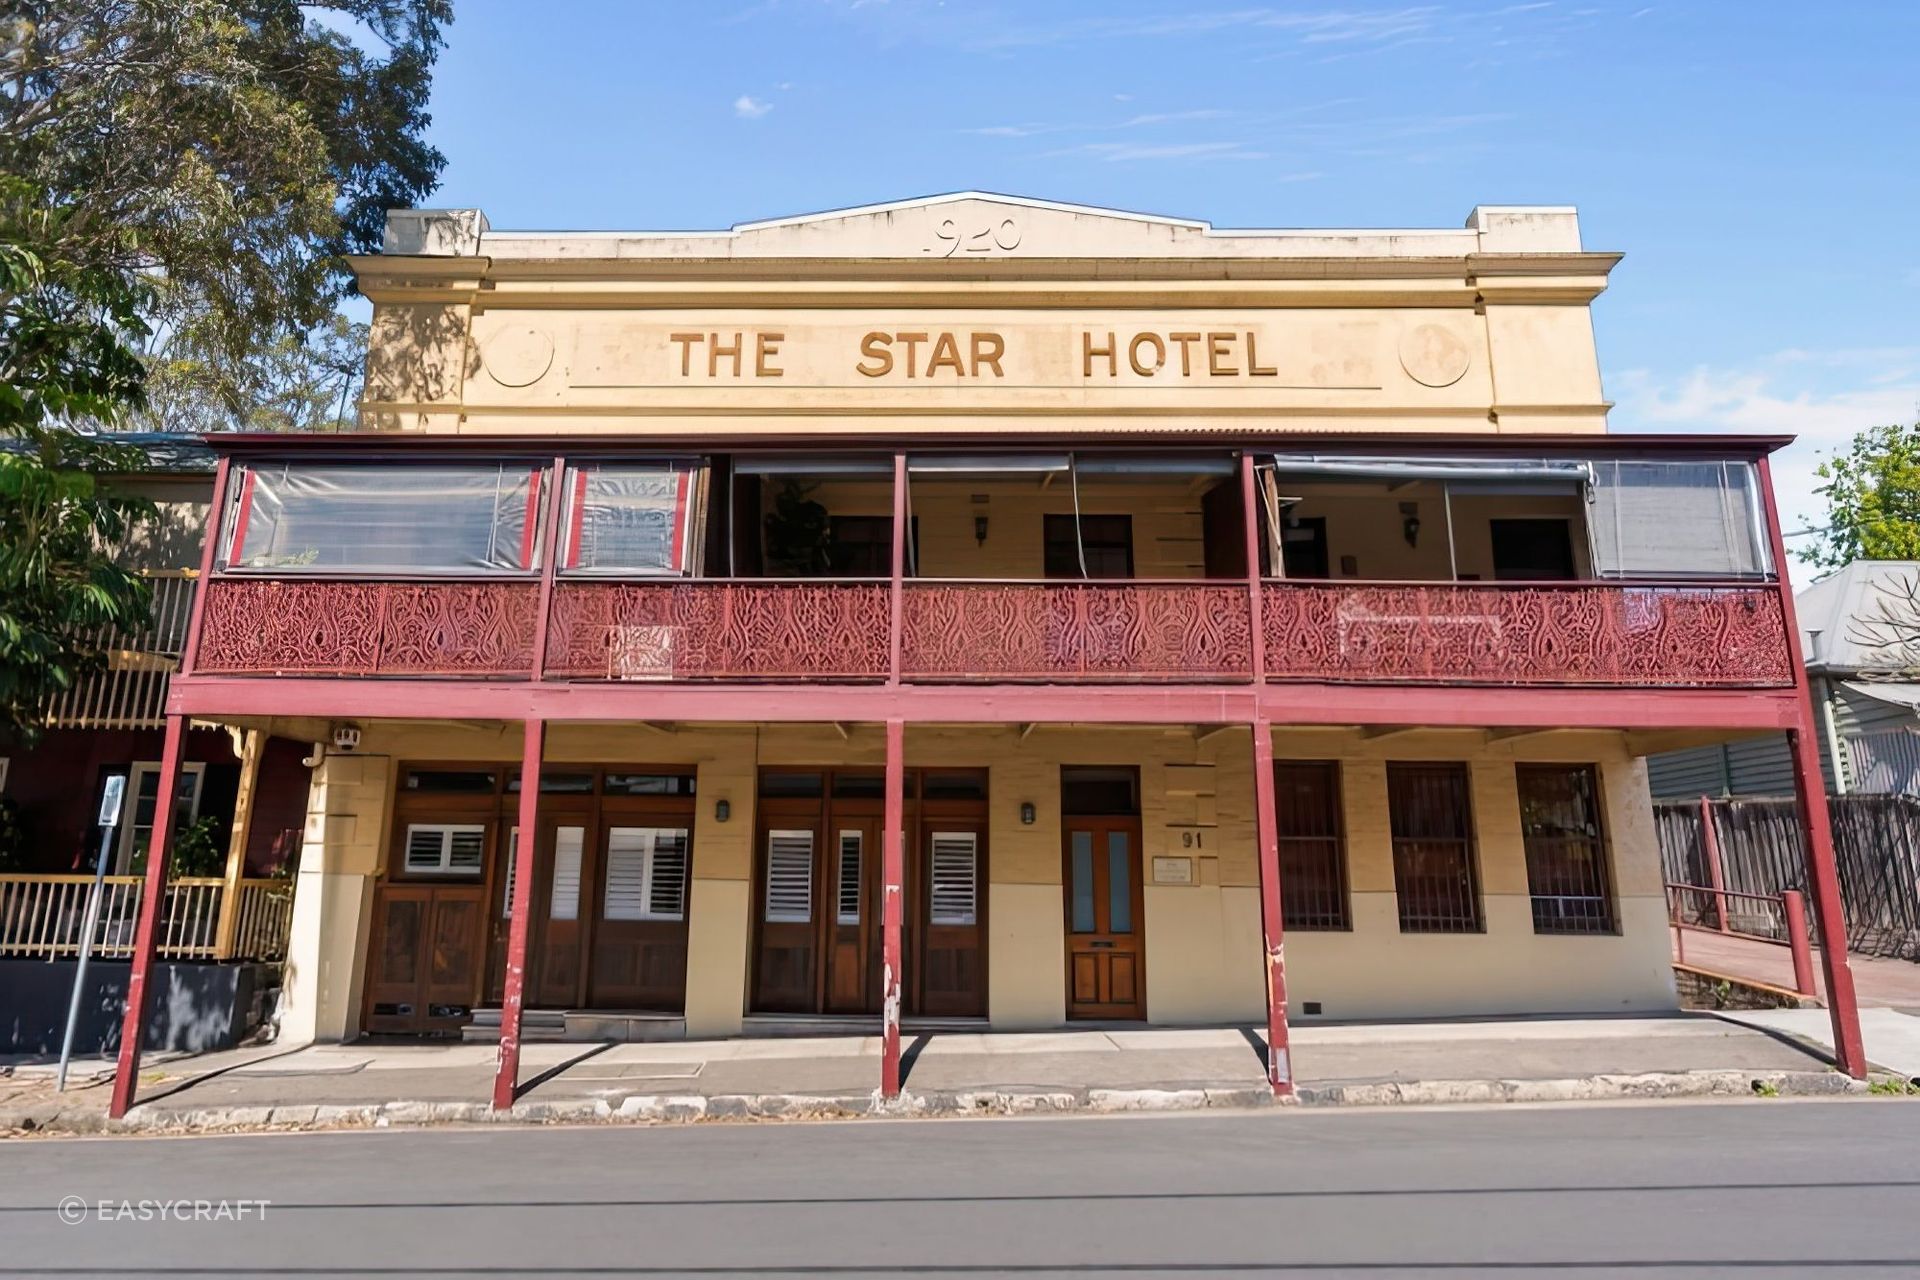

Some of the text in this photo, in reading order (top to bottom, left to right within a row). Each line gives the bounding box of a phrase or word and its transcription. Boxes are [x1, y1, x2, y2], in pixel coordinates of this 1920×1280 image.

[922, 219, 1022, 257] 920
[670, 332, 1278, 378] THE STAR HOTEL
[1182, 832, 1202, 849] 91
